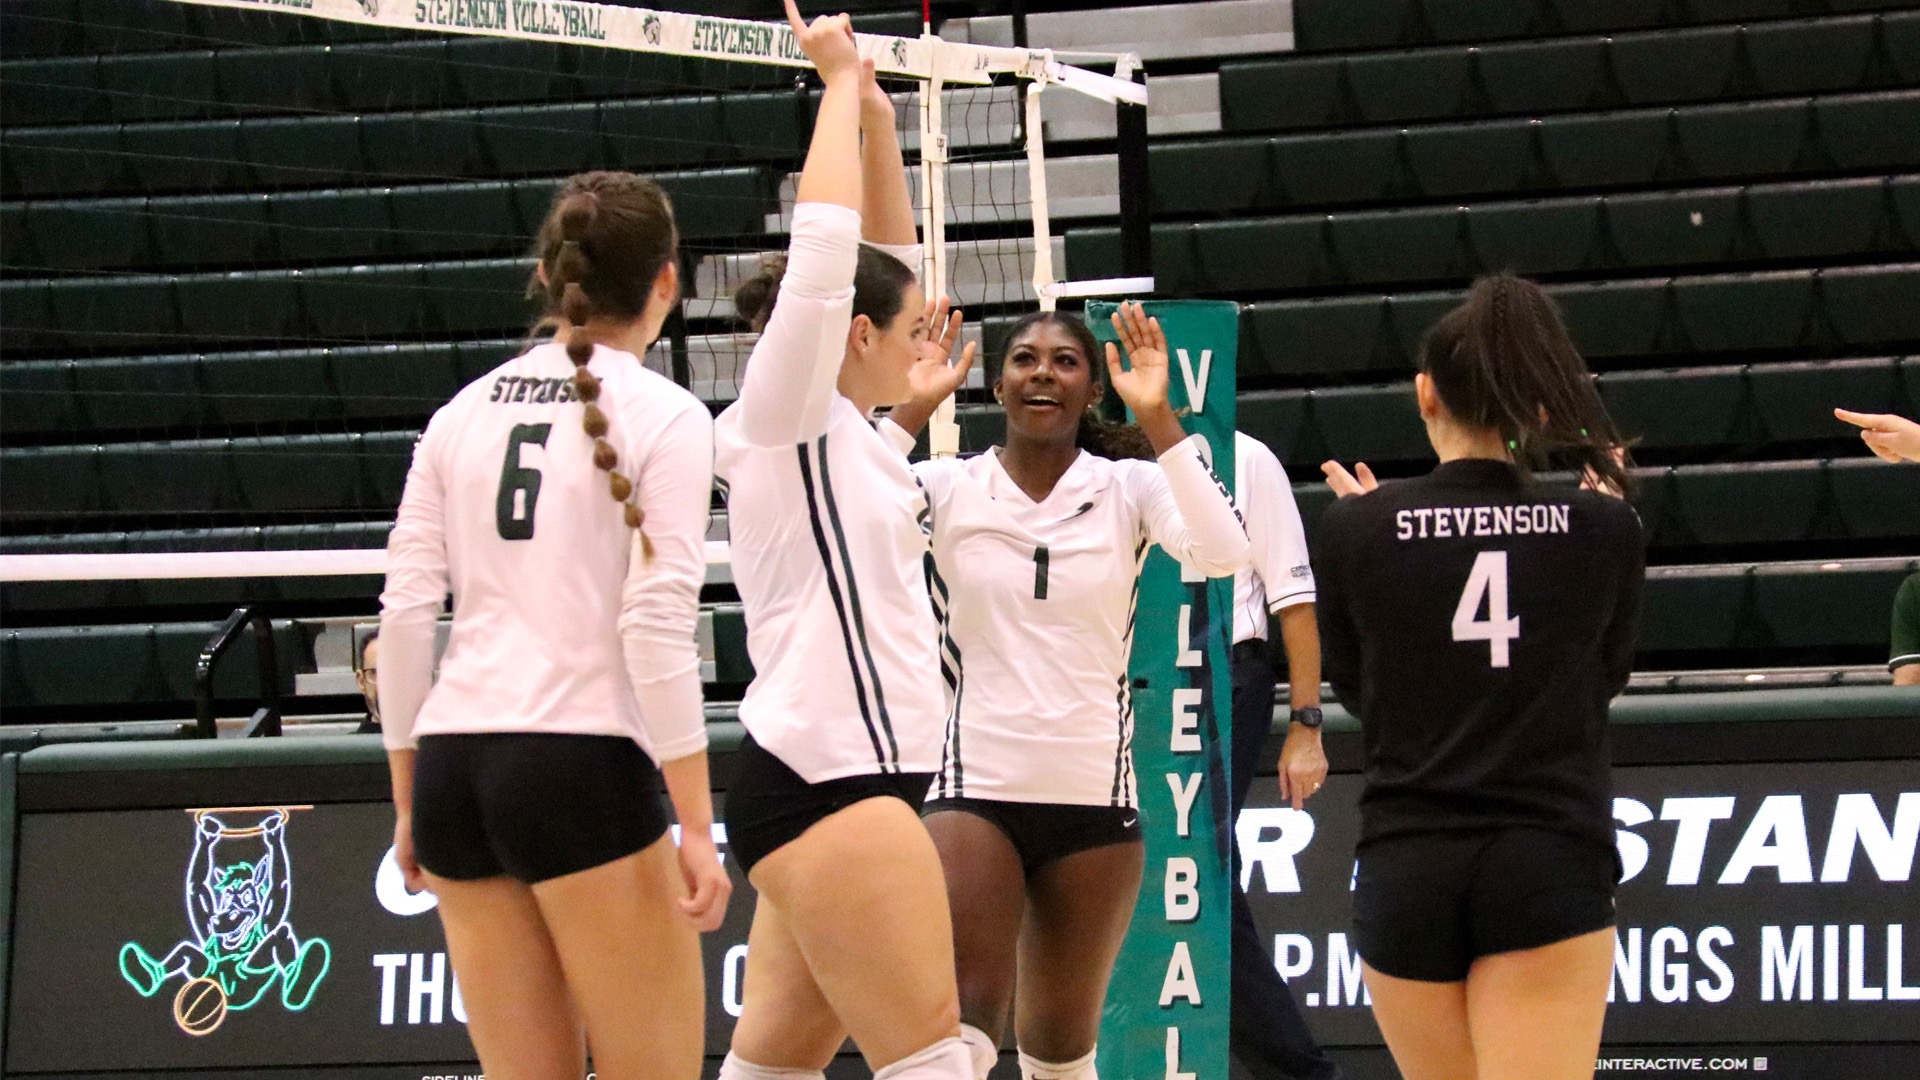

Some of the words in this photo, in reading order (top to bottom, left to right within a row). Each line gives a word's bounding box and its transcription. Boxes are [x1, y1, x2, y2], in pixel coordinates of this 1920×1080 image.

[415, 0, 507, 29] STEVENSON
[512, 0, 606, 40] VOLLEYBALL
[693, 20, 775, 57] STEVENSON
[490, 376, 603, 403] STEVENS
[496, 423, 553, 540] 6
[1397, 504, 1570, 540] STEVENSON
[1033, 547, 1050, 600] 1
[1452, 550, 1520, 668] 4
[1605, 925, 1735, 1003] NGS
[1594, 1057, 1748, 1071] INTERACTIVE.COM
